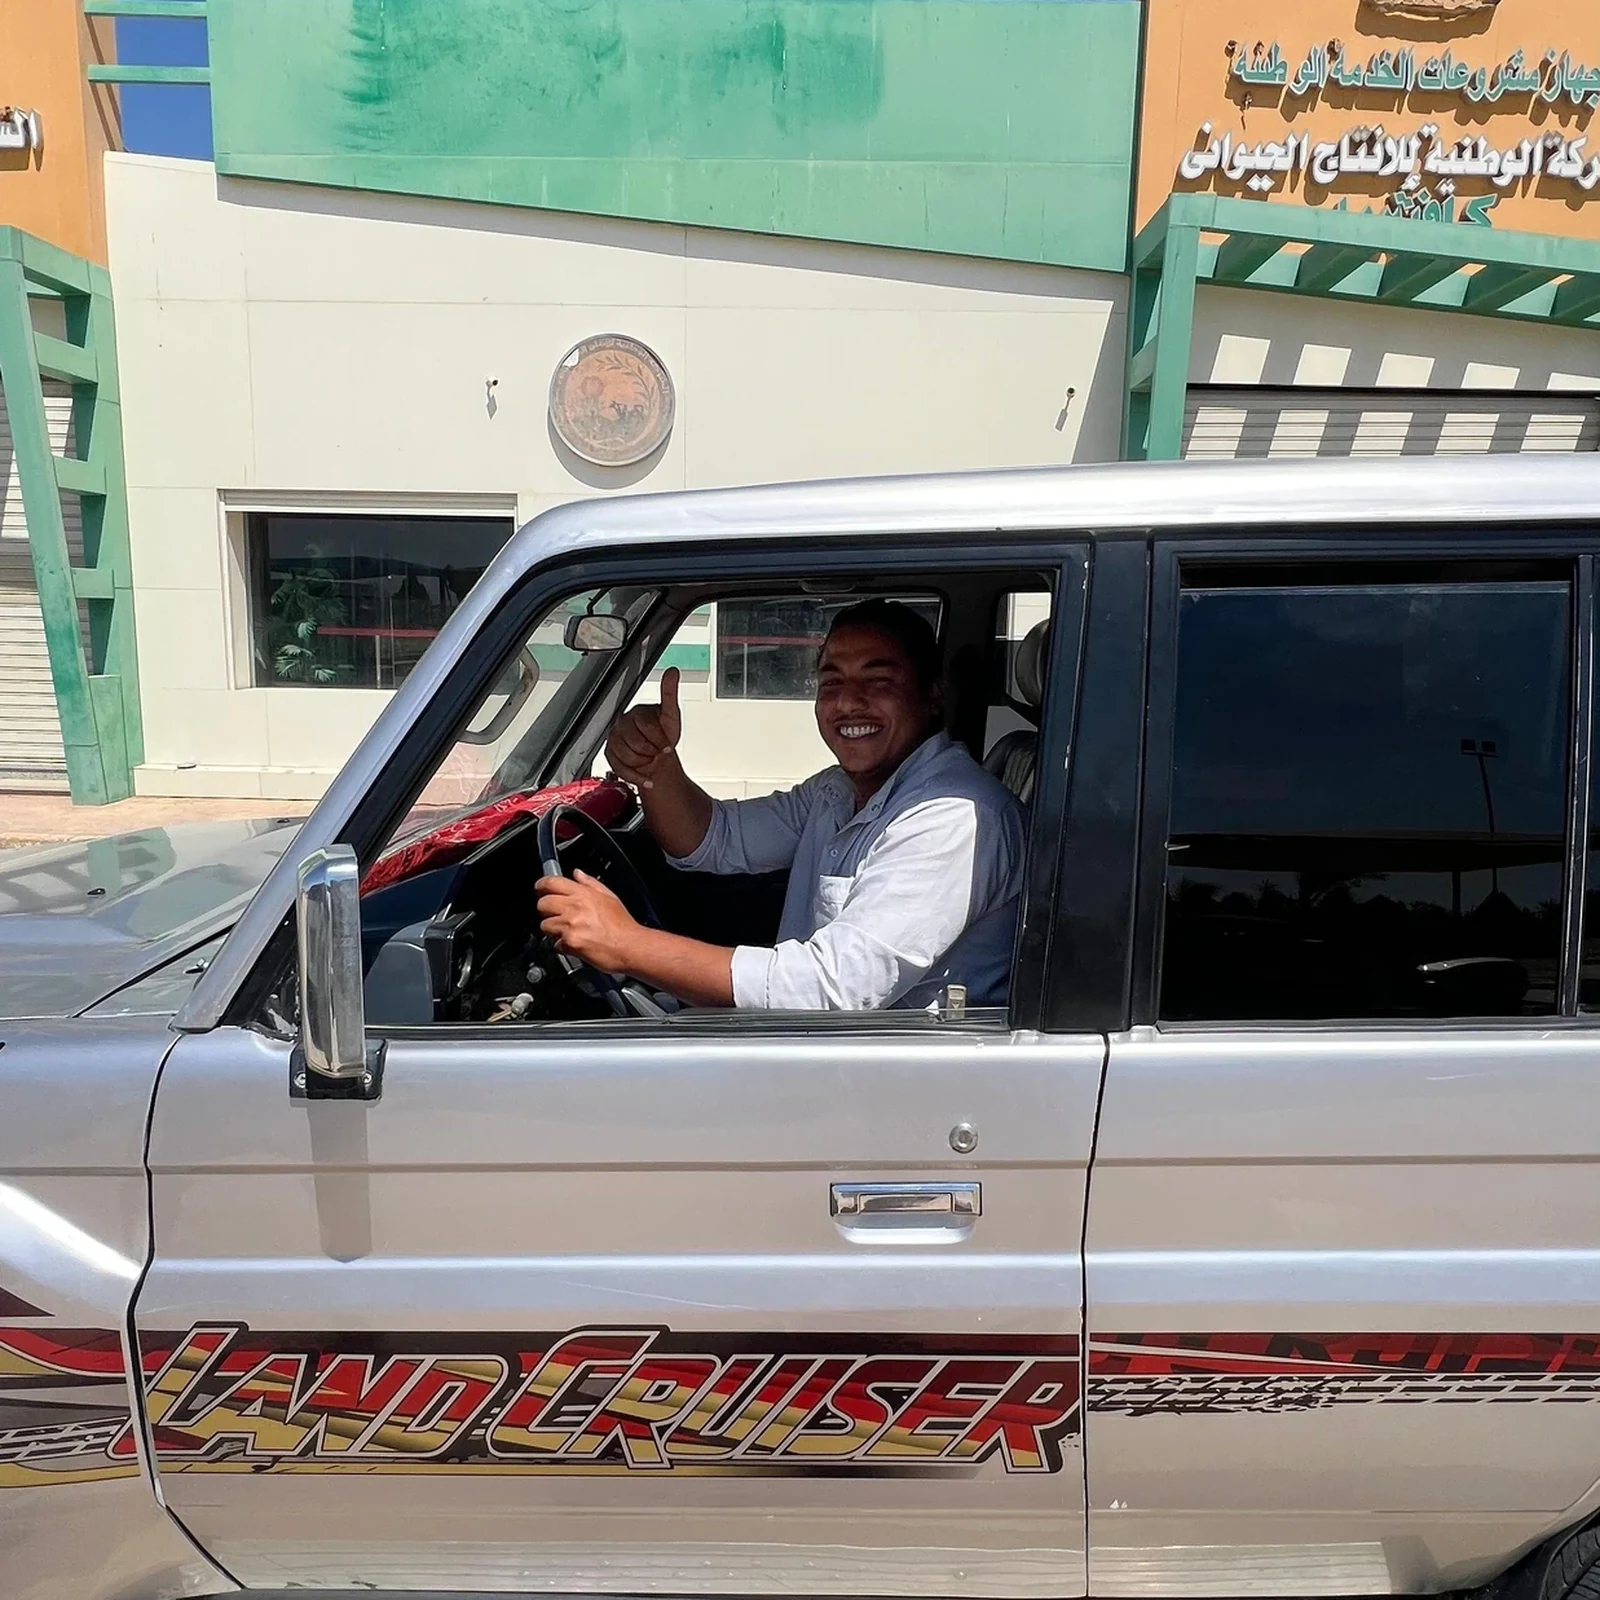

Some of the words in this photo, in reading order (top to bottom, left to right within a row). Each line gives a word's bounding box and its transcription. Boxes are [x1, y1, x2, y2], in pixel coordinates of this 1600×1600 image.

[1418, 48, 1541, 102] مشروعات
[1423, 123, 1544, 196] الوطنية
[106, 1325, 509, 1460] LAND
[487, 1329, 1081, 1473] CRUISER
